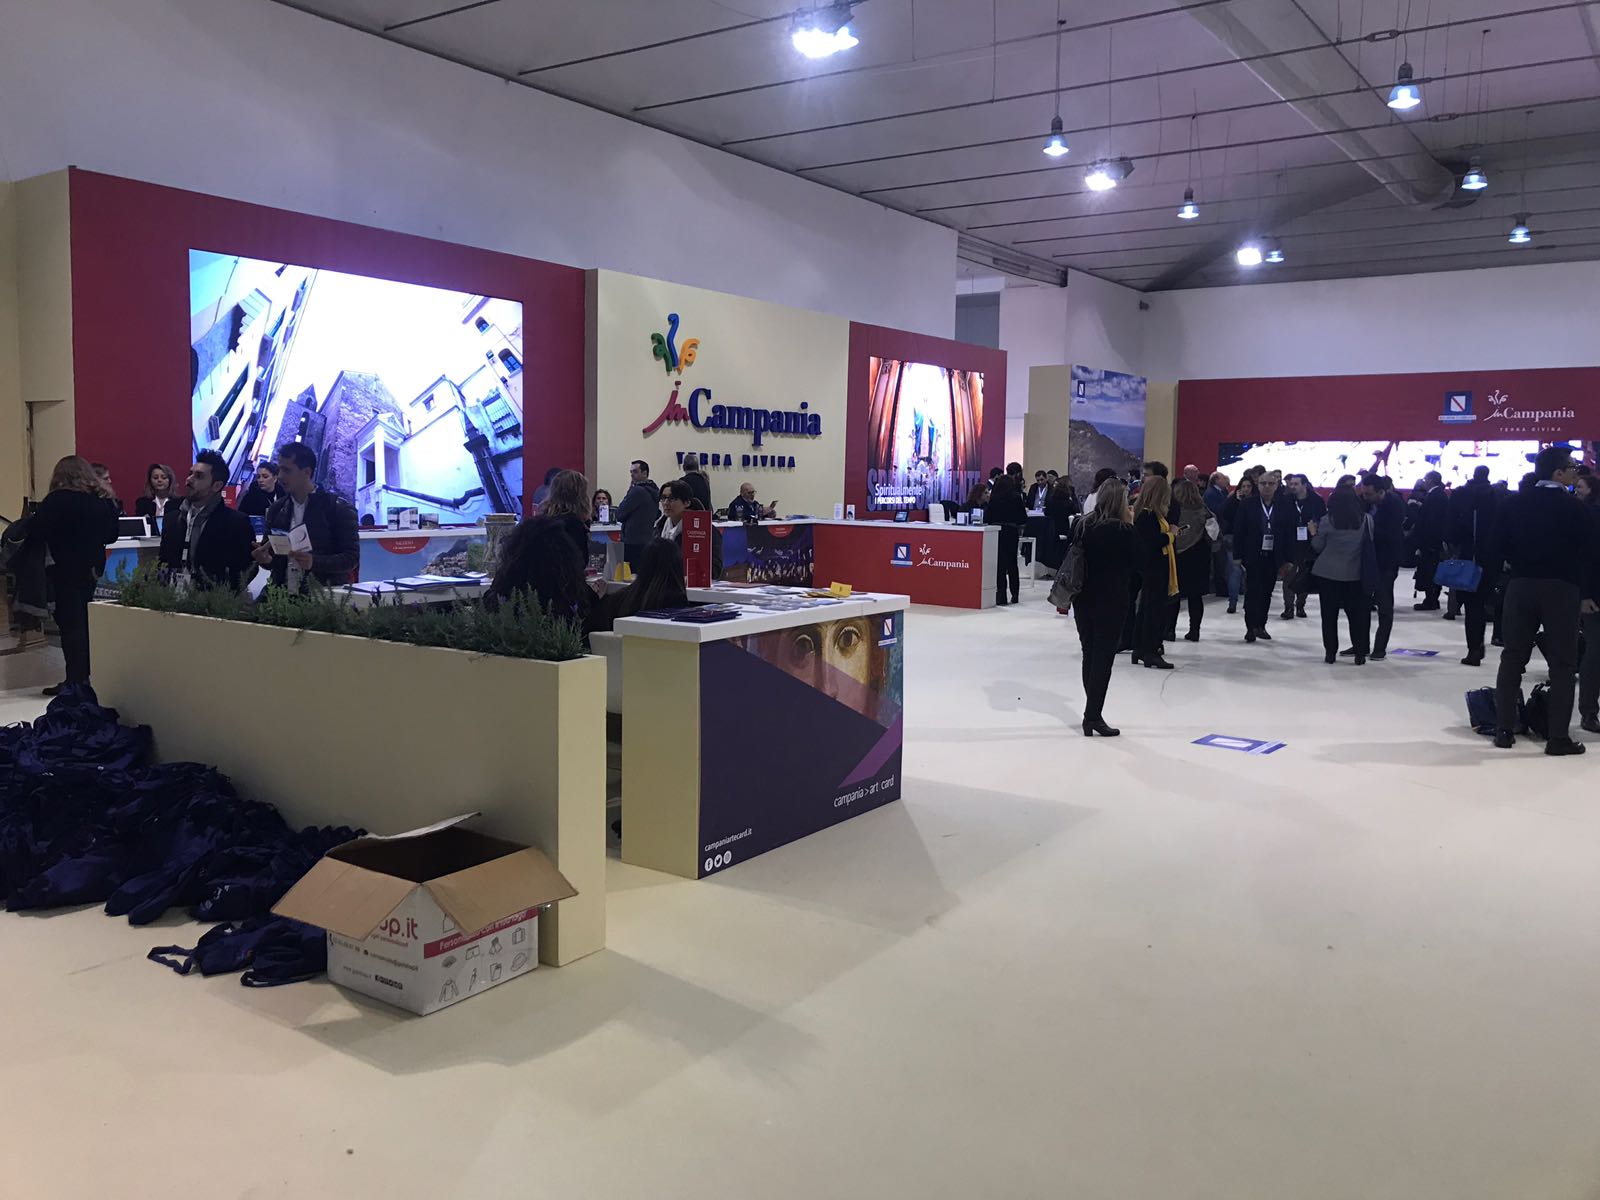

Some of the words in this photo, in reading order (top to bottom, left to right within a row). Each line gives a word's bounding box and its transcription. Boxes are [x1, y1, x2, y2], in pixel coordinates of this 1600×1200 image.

[676, 452, 732, 466] TRRA
[742, 455, 796, 468] DIVINA
[875, 483, 922, 498] Spiritualmente
[881, 774, 895, 790] card
[705, 828, 752, 851] campaniartecard.it
